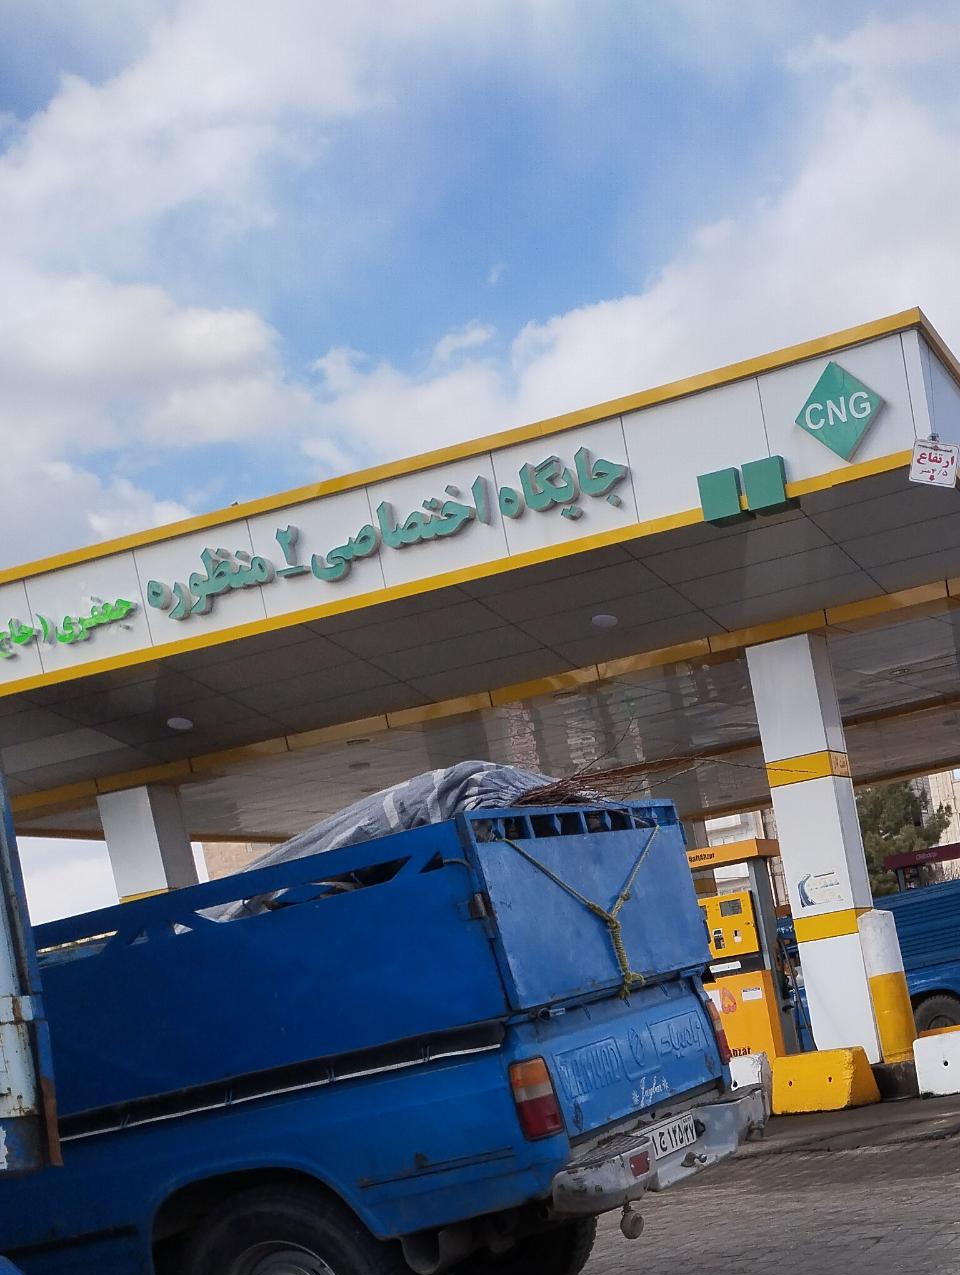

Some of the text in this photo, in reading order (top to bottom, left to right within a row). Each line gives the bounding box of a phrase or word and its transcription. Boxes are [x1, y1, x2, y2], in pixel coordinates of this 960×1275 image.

[805, 392, 871, 430] CNG
[499, 446, 628, 520] جایگاه
[917, 451, 955, 469] ارتفاع
[310, 475, 490, 582] اختصاصی
[147, 546, 274, 621] منظوره
